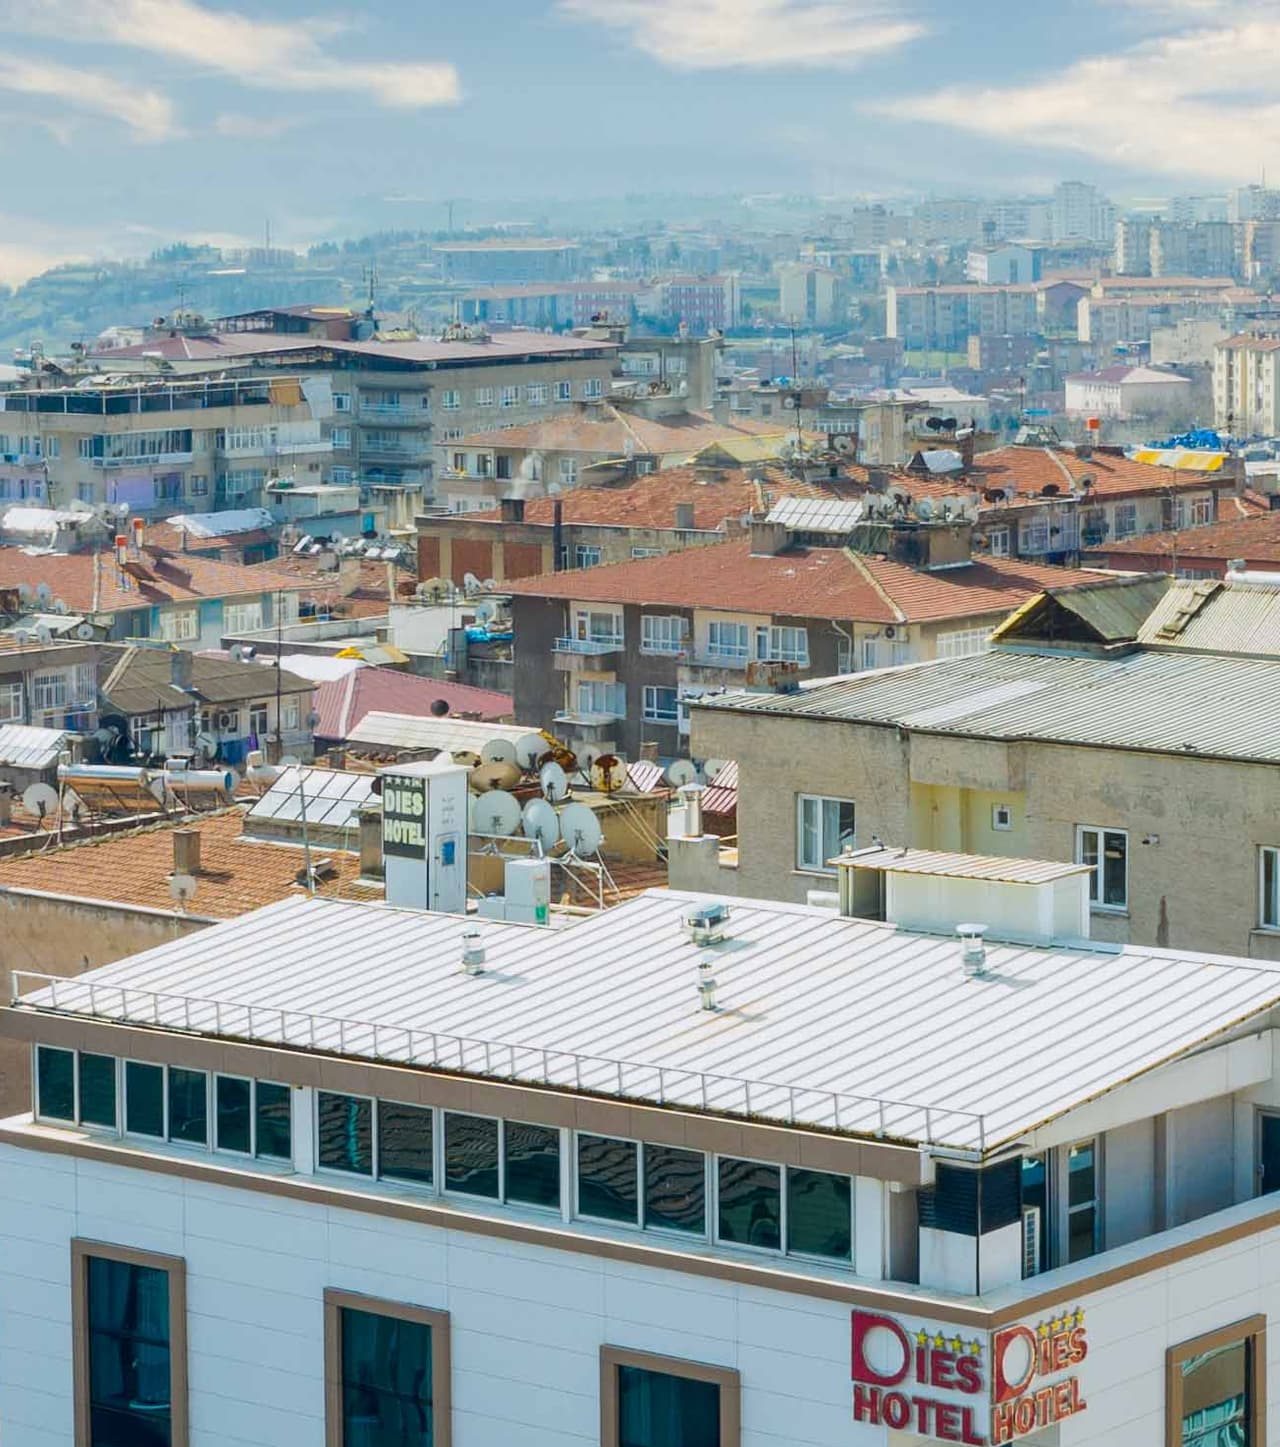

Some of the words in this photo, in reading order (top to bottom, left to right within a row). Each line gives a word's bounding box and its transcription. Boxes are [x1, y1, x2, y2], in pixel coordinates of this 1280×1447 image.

[384, 789, 424, 816] DIES
[384, 818, 425, 846] HOTEL
[853, 1383, 985, 1446] HOTEL
[991, 1376, 1087, 1446] HOTEL
